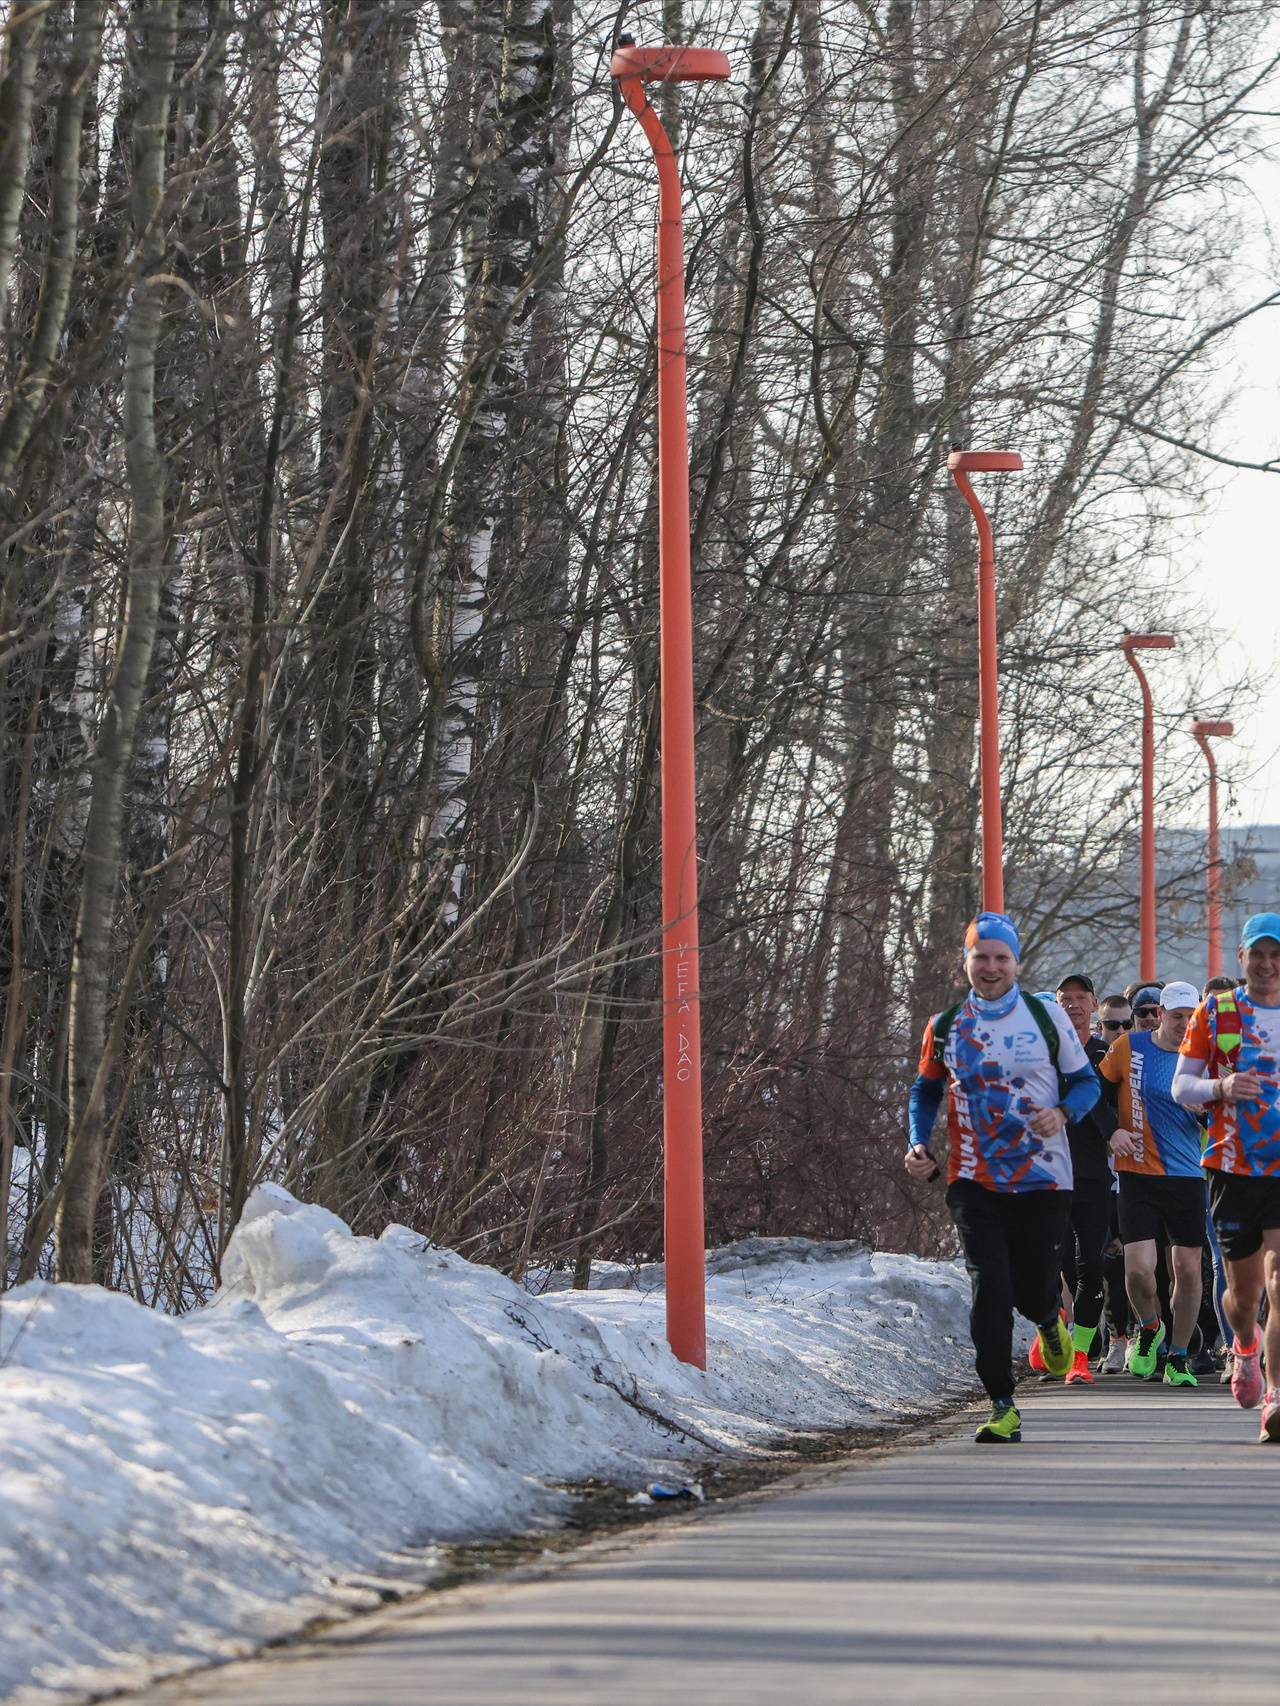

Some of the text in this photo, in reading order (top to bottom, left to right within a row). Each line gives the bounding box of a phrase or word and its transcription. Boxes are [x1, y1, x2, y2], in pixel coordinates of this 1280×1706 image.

[1129, 1050, 1145, 1130] ZEPPELIN
[957, 1133, 979, 1180] RUN
[1220, 1122, 1237, 1174] RUN
